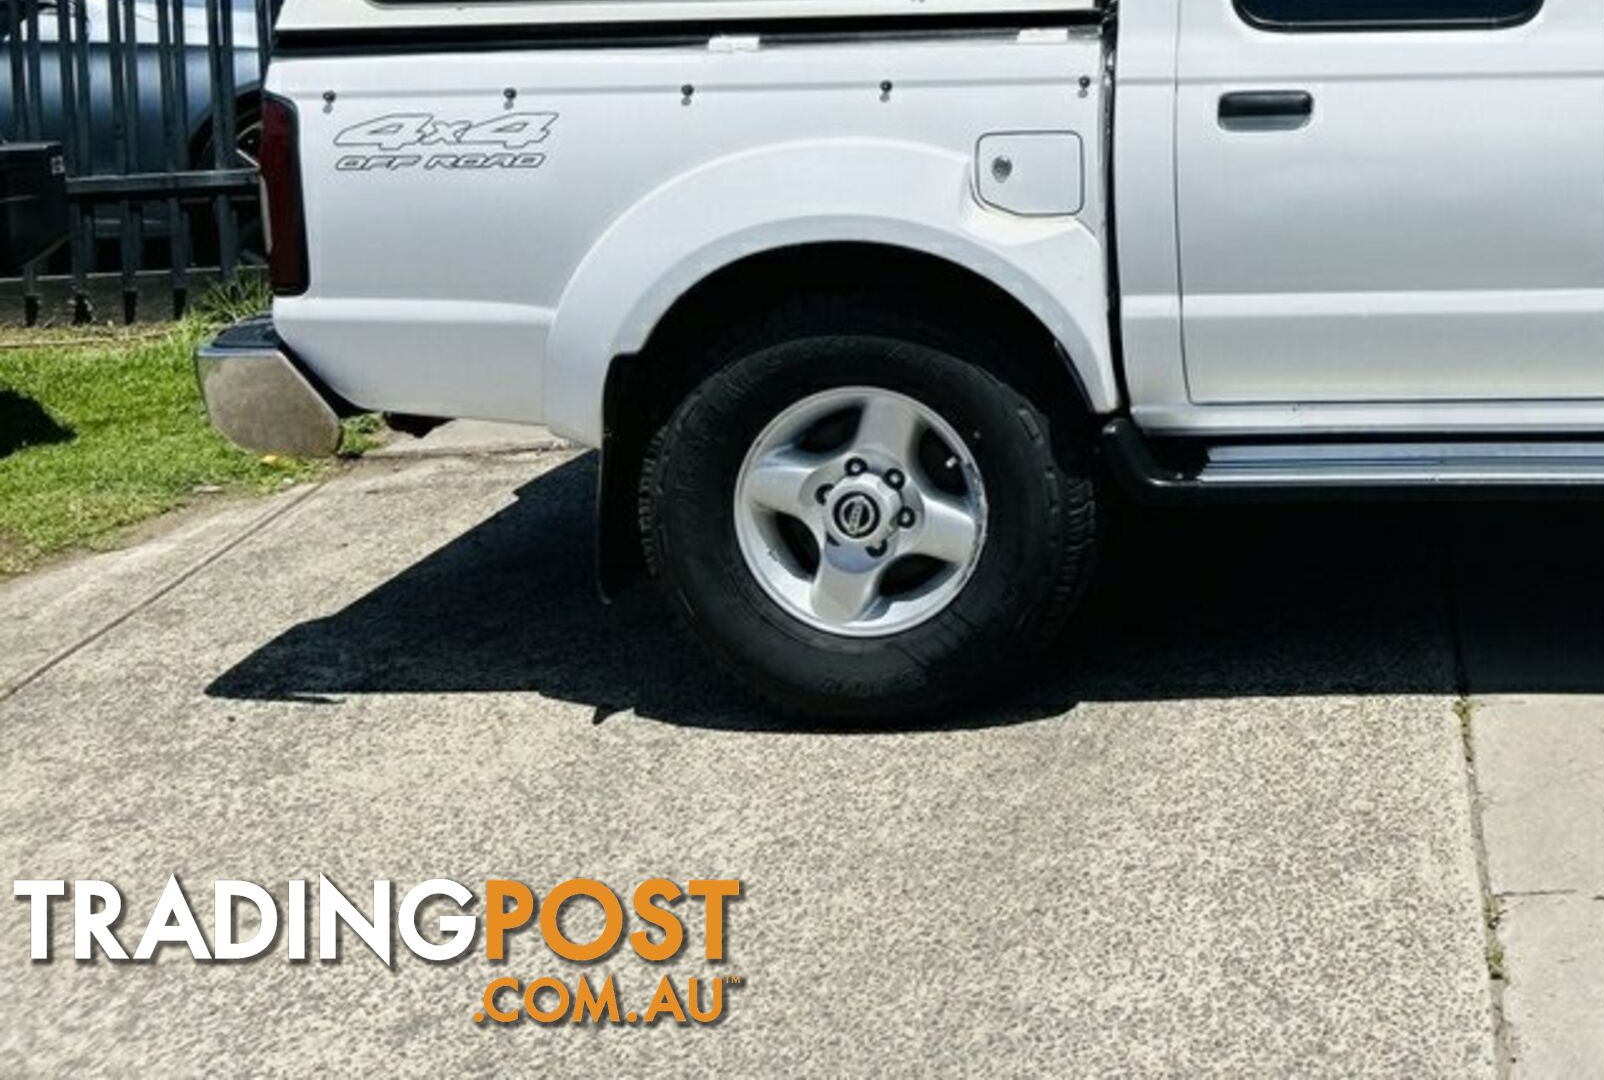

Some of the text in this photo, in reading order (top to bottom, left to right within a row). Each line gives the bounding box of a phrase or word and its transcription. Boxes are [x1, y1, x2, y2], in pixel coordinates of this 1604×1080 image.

[333, 111, 559, 150] 4x4
[335, 152, 546, 170] OFF ROAD
